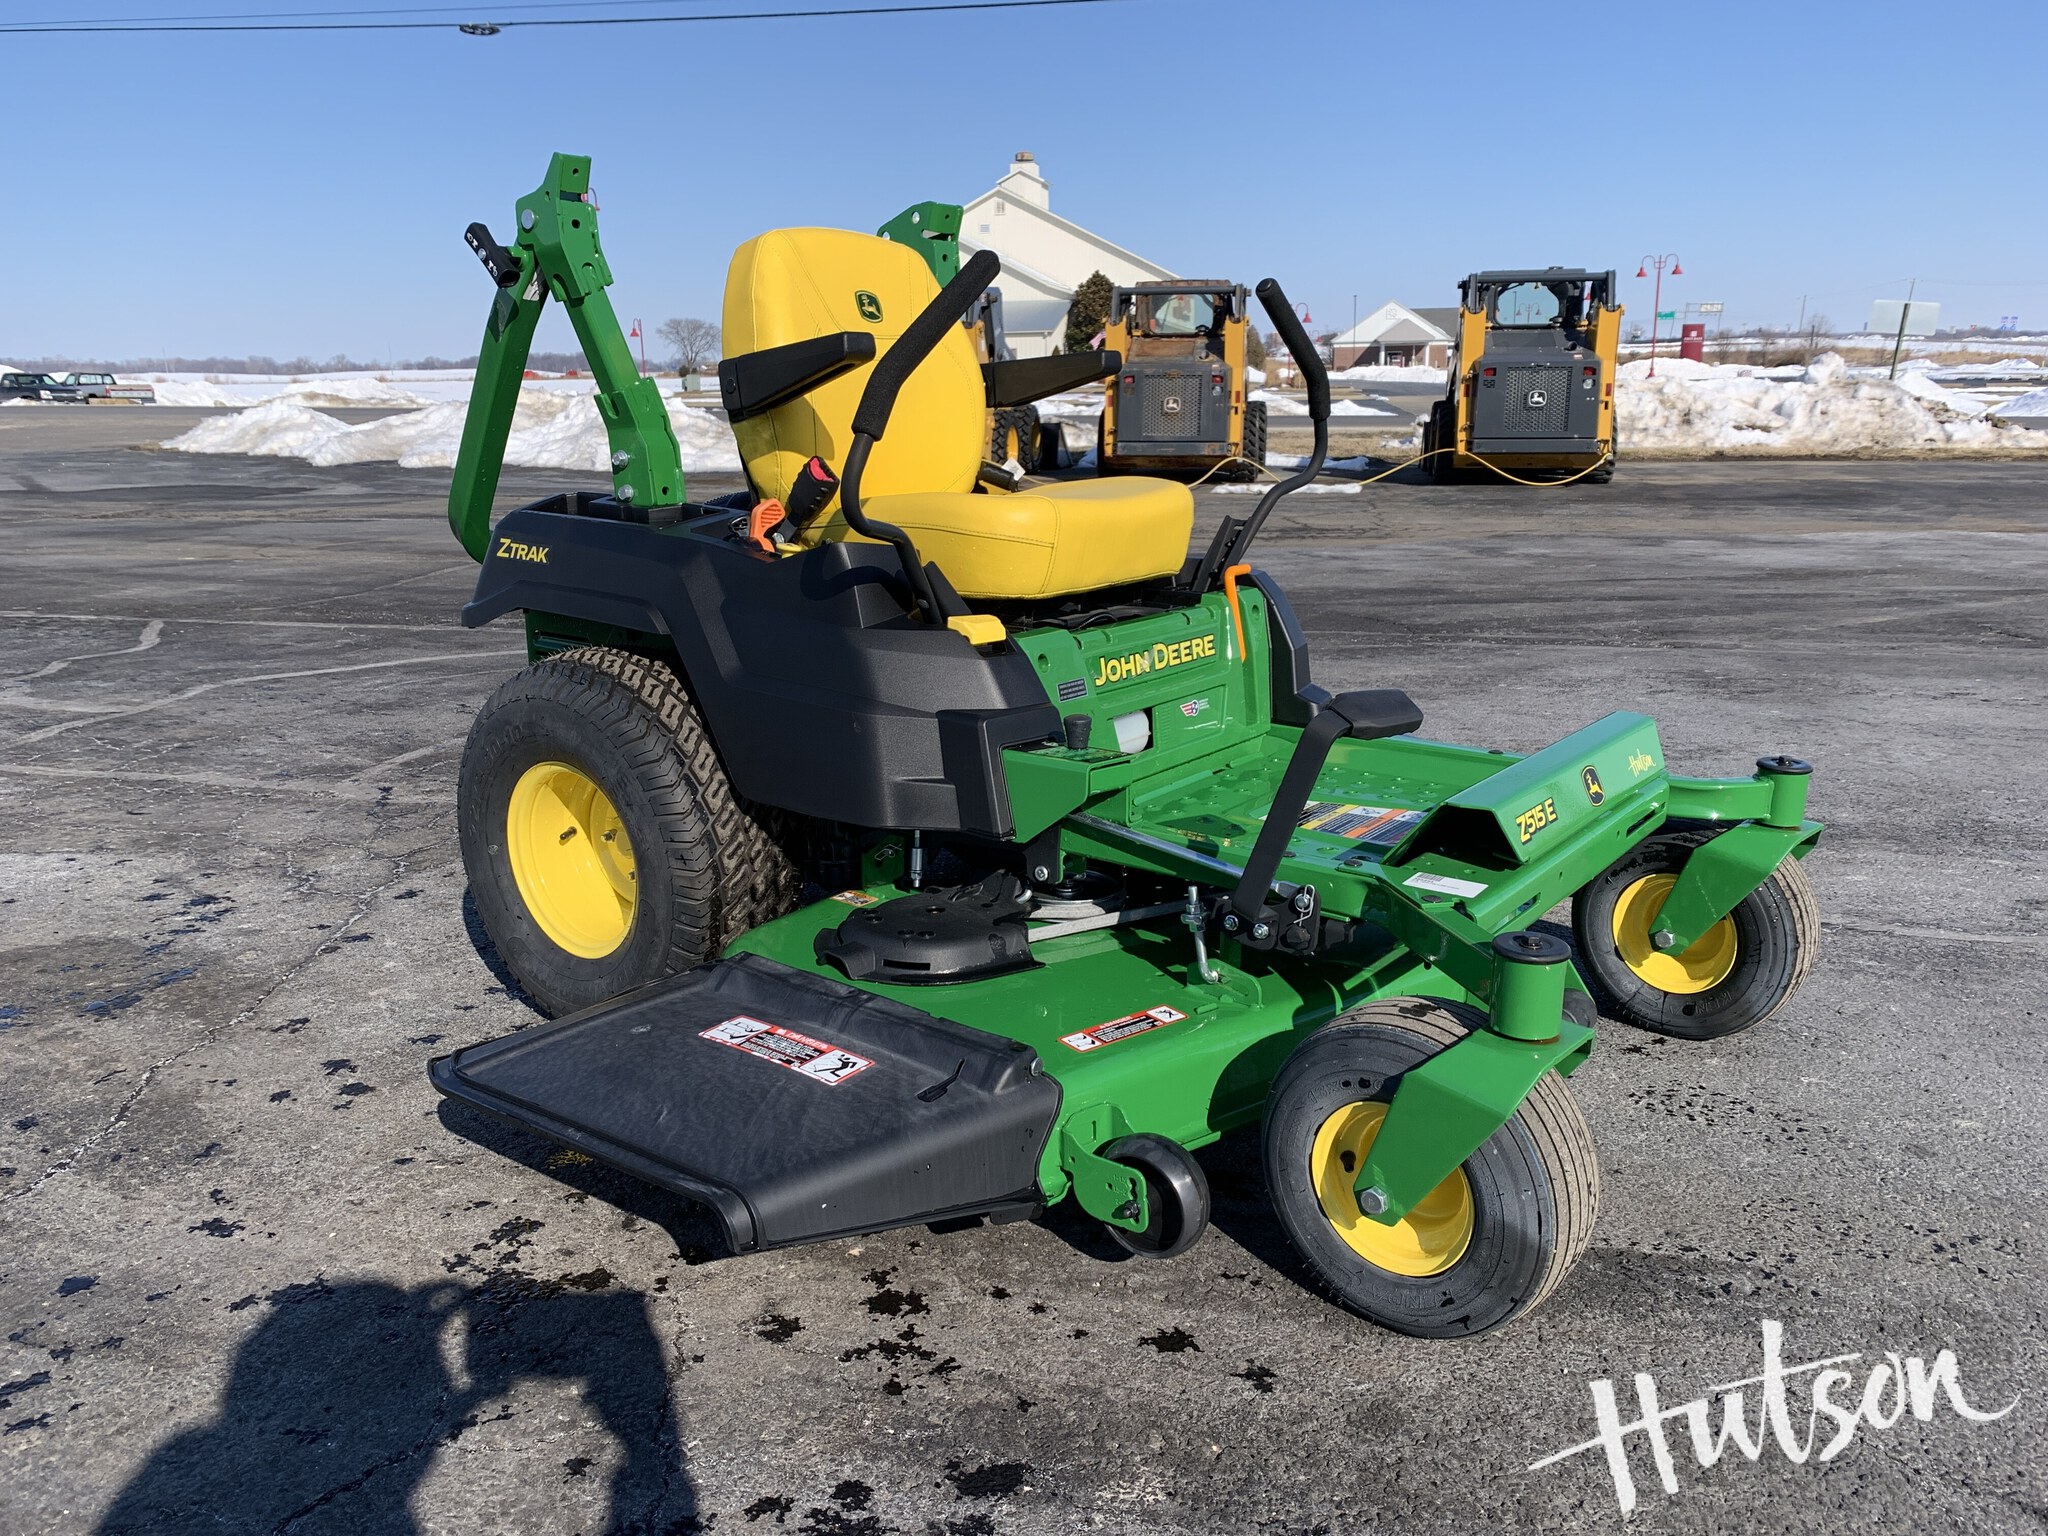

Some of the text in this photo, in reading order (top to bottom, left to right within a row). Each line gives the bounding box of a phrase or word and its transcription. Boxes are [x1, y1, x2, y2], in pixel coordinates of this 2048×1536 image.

[1095, 634, 1216, 687] JOHN DEERE
[1627, 748, 1657, 778] Hutson
[1515, 797, 1558, 844] Z515 E
